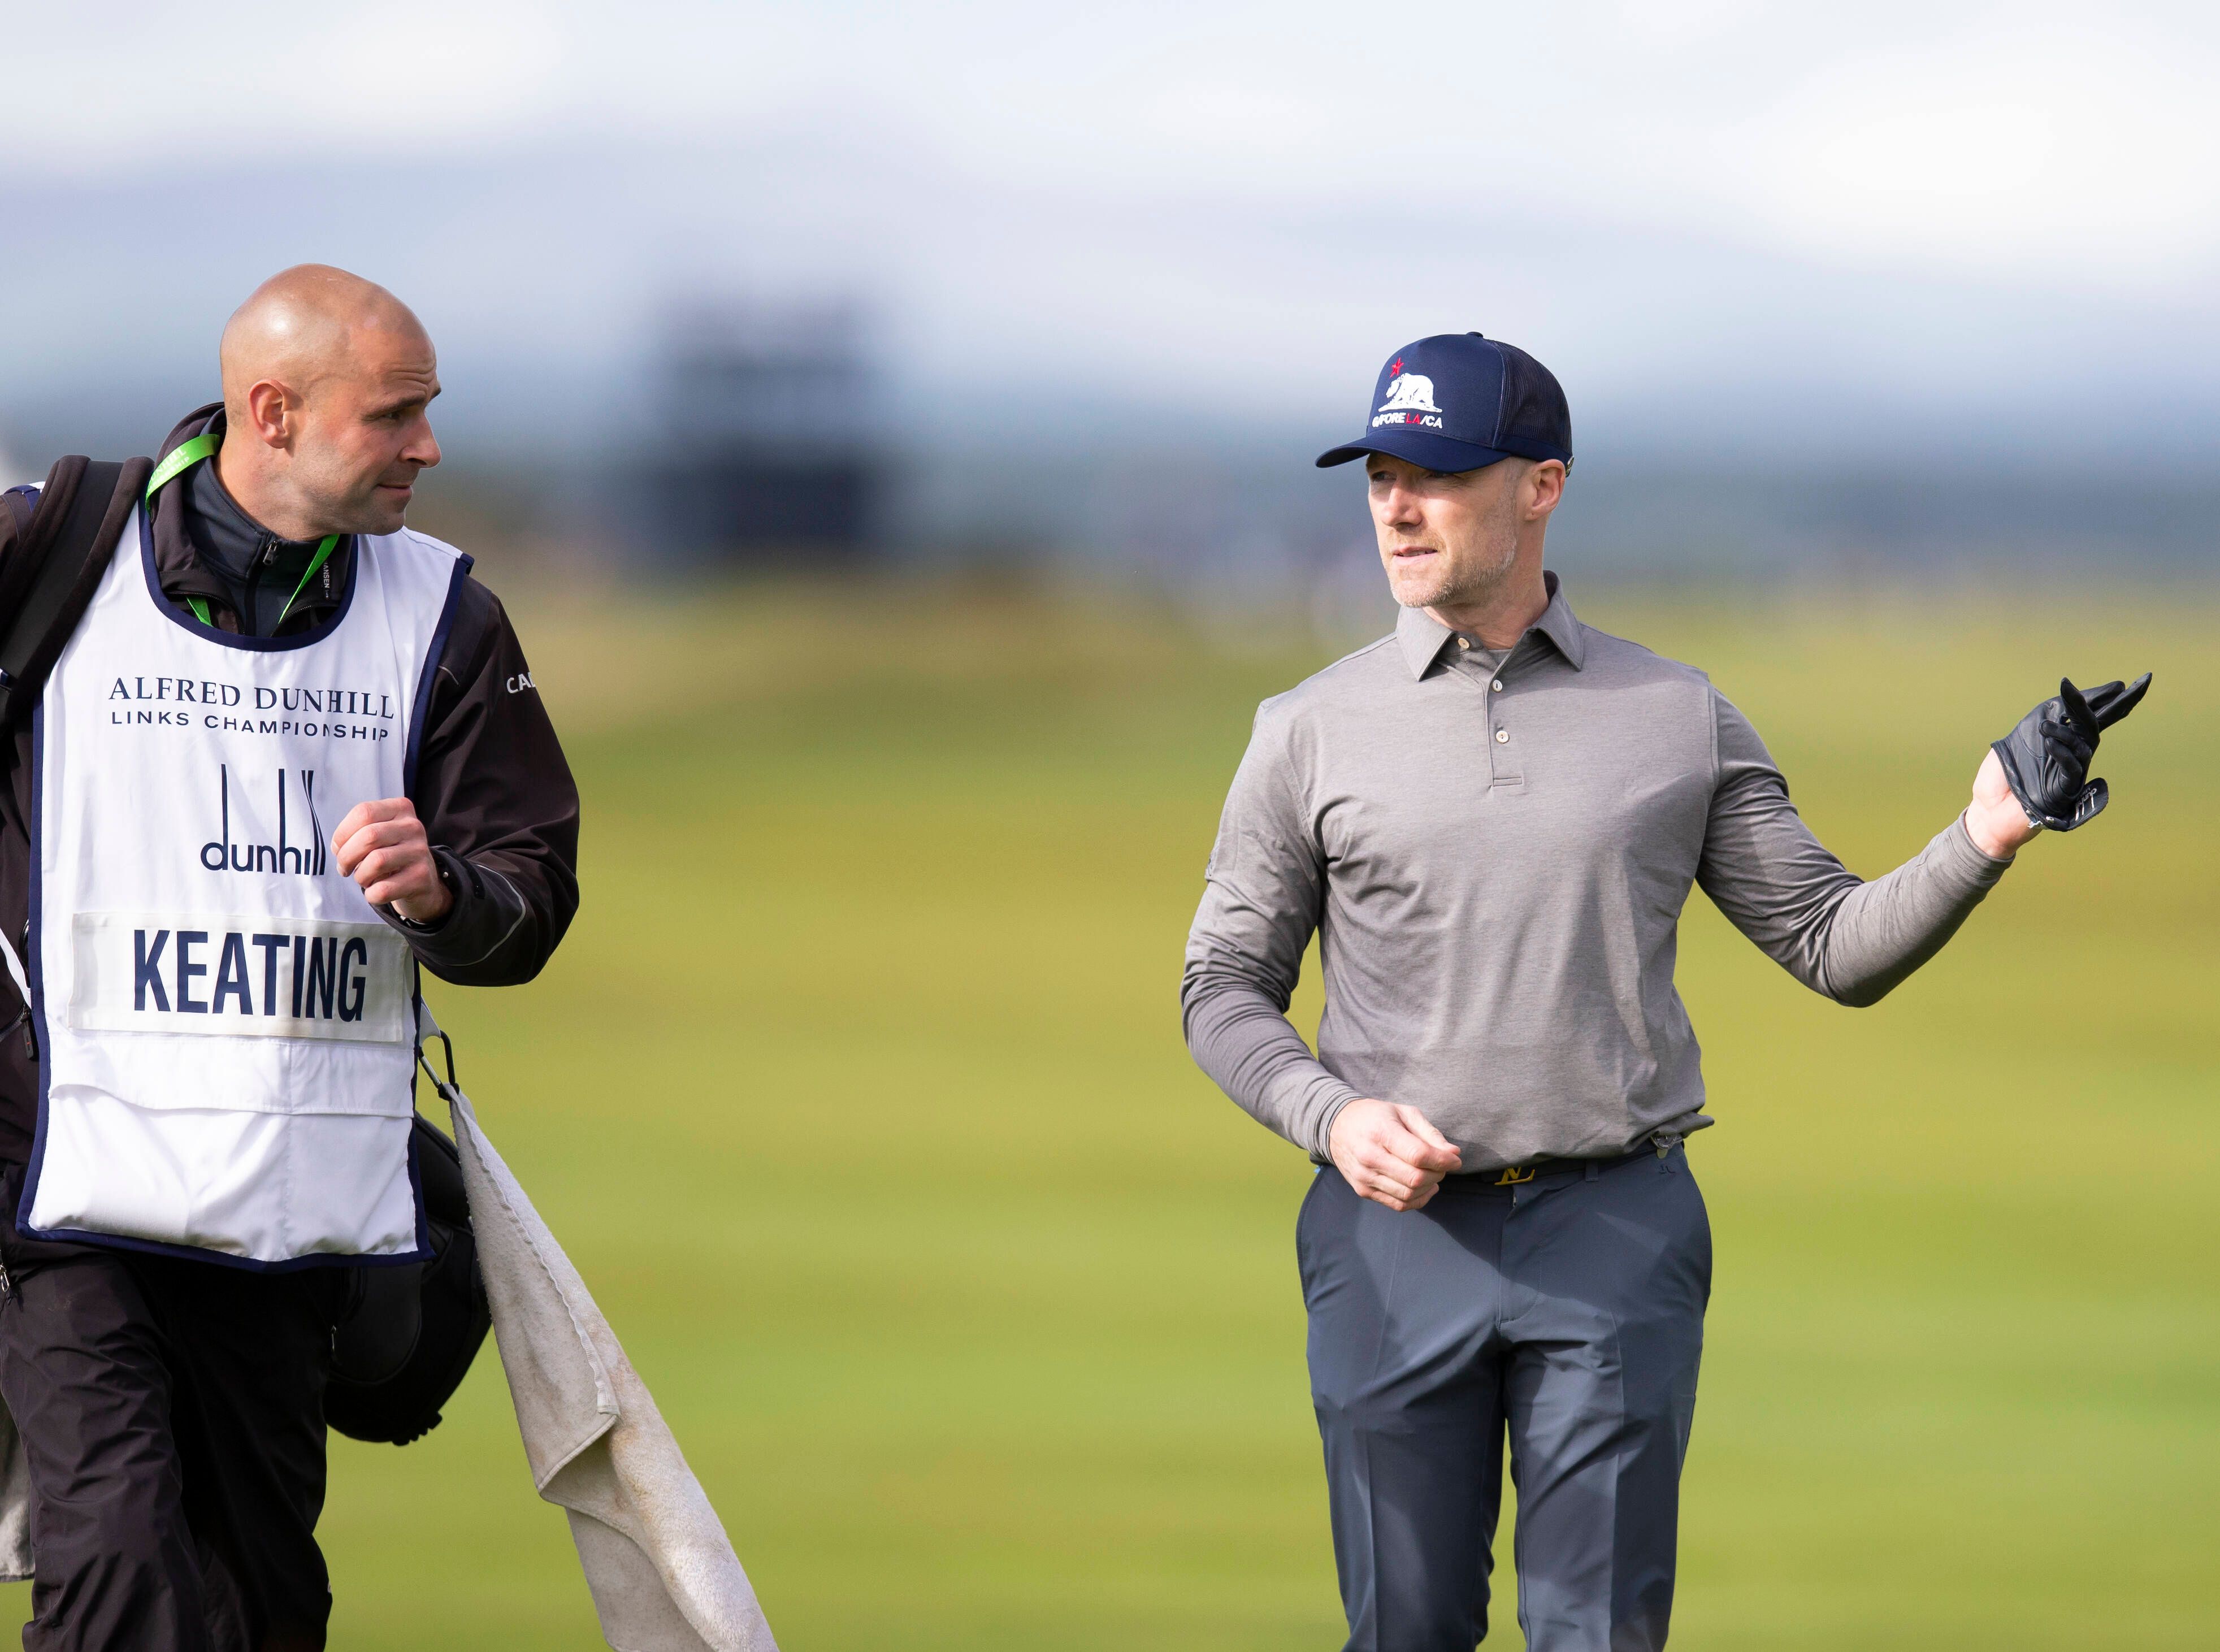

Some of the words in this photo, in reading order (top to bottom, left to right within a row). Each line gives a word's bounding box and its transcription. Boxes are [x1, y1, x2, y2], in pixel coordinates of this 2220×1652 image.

[108, 677, 241, 706] ALFRED
[254, 687, 394, 719] DUNHILL
[112, 711, 190, 726] LINKS
[204, 715, 389, 742] CHAMPIONSHIP
[200, 763, 326, 876] dunhill
[134, 929, 367, 1022] KEATING
